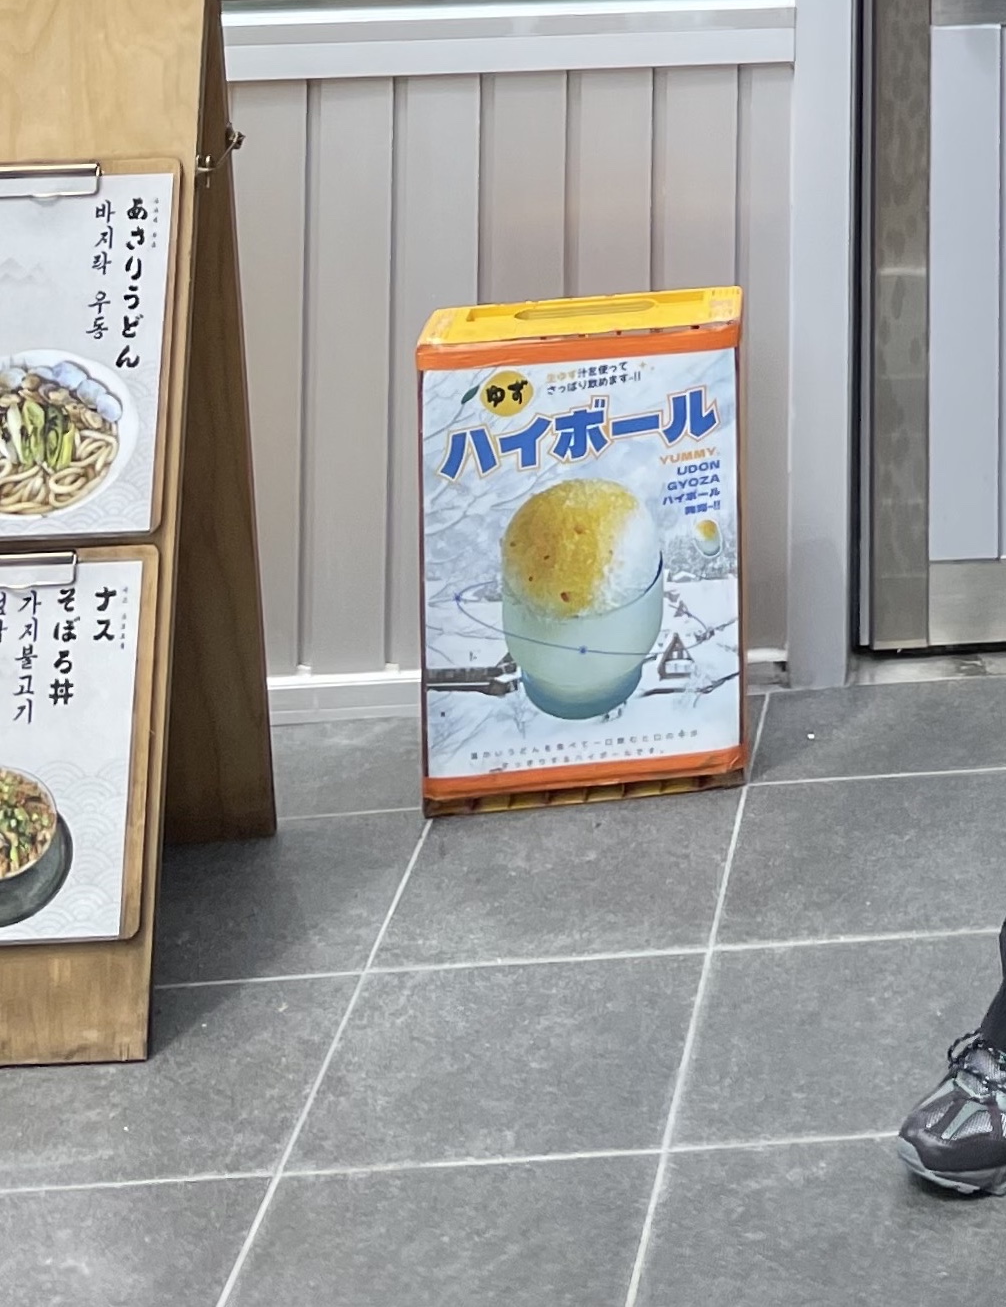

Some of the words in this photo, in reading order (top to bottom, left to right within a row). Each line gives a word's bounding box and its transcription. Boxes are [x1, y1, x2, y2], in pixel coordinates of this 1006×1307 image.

[91, 199, 116, 276] 바지락
[115, 197, 148, 369] あさりうどん
[85, 290, 112, 340] 우동
[484, 379, 529, 408] ゆず
[440, 390, 719, 479] ハイボール
[667, 474, 721, 491] GYOZA
[677, 460, 720, 476] UDON
[93, 586, 118, 642] ナス
[12, 589, 43, 725] 가지불고기
